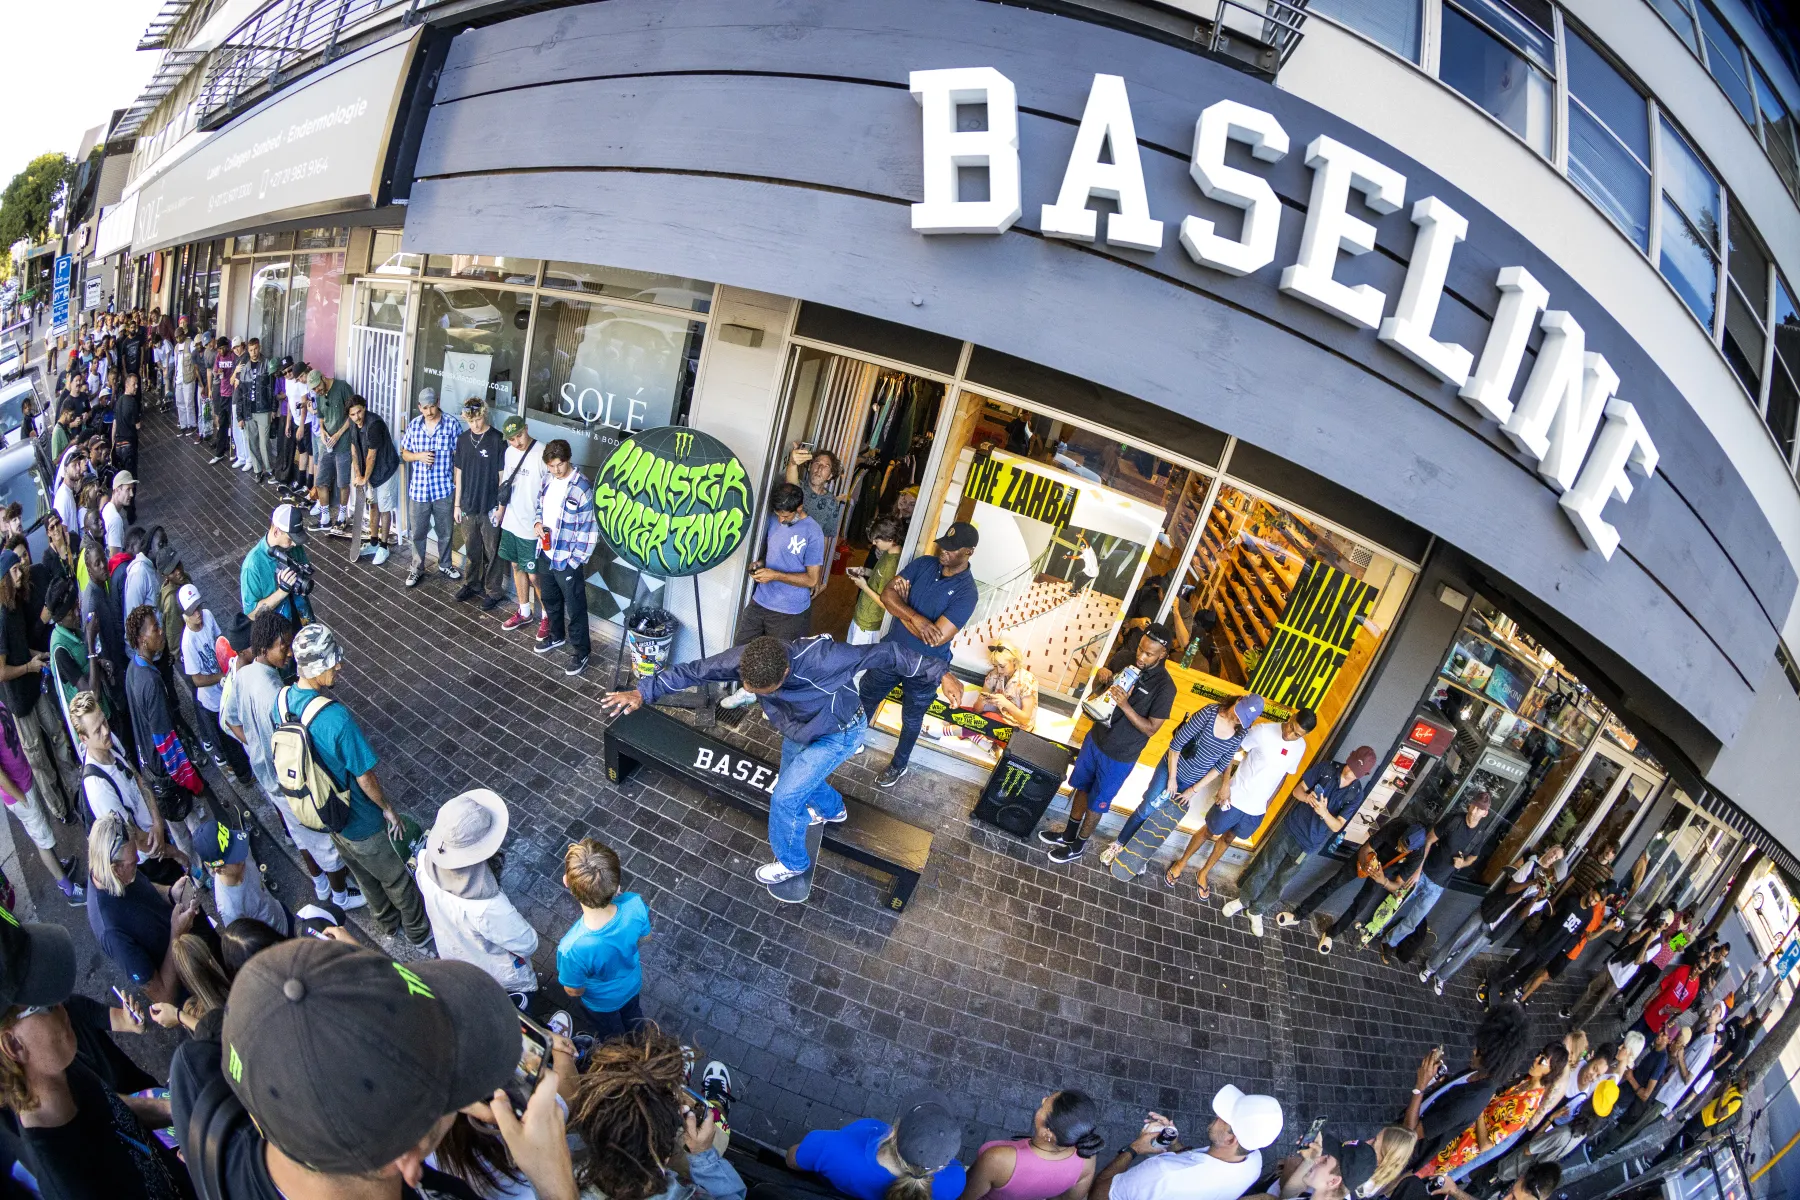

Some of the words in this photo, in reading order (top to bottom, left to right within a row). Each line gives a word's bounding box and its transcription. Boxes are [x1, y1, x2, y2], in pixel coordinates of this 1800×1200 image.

[287, 97, 368, 143] Endermologie
[59, 260, 67, 273] P
[909, 66, 1660, 561] BASELINE
[558, 383, 647, 435] SOLÉ
[572, 428, 591, 438] SKIN
[602, 436, 622, 447] BOD
[598, 439, 750, 515] MONSTER
[967, 456, 1004, 504] THE
[1000, 466, 1078, 530] ZAHBA
[595, 483, 671, 571] SUPER
[670, 507, 744, 571] TOUR
[1278, 558, 1380, 652] MAKE
[1244, 628, 1347, 712] IMPACT
[1485, 757, 1525, 777] OAKLEY
